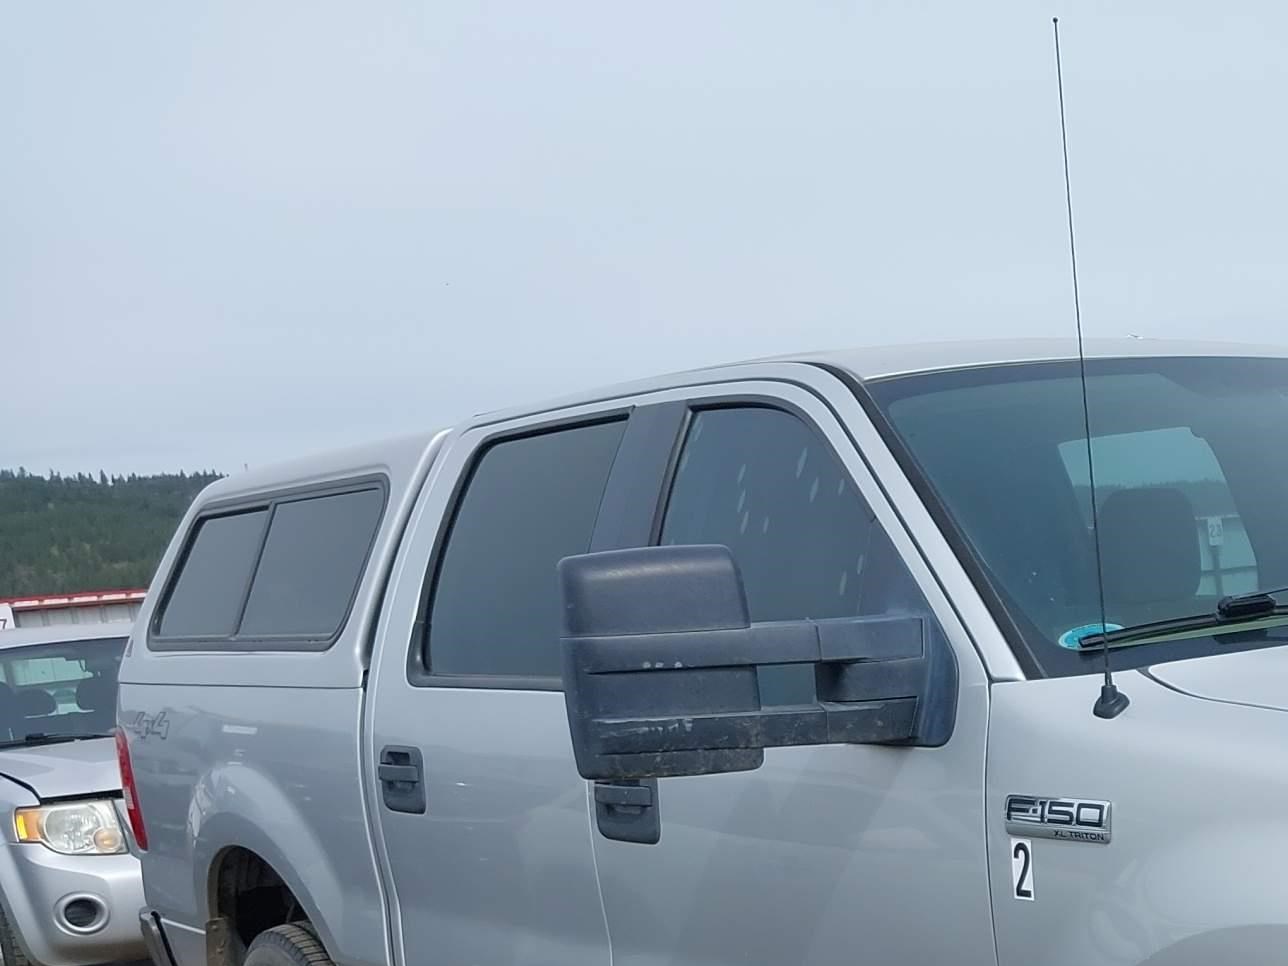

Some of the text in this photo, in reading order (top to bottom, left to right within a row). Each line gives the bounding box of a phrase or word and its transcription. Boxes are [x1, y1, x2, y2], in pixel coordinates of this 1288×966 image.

[1053, 830, 1105, 841] XL TRITON
[1013, 841, 1033, 899] 2
